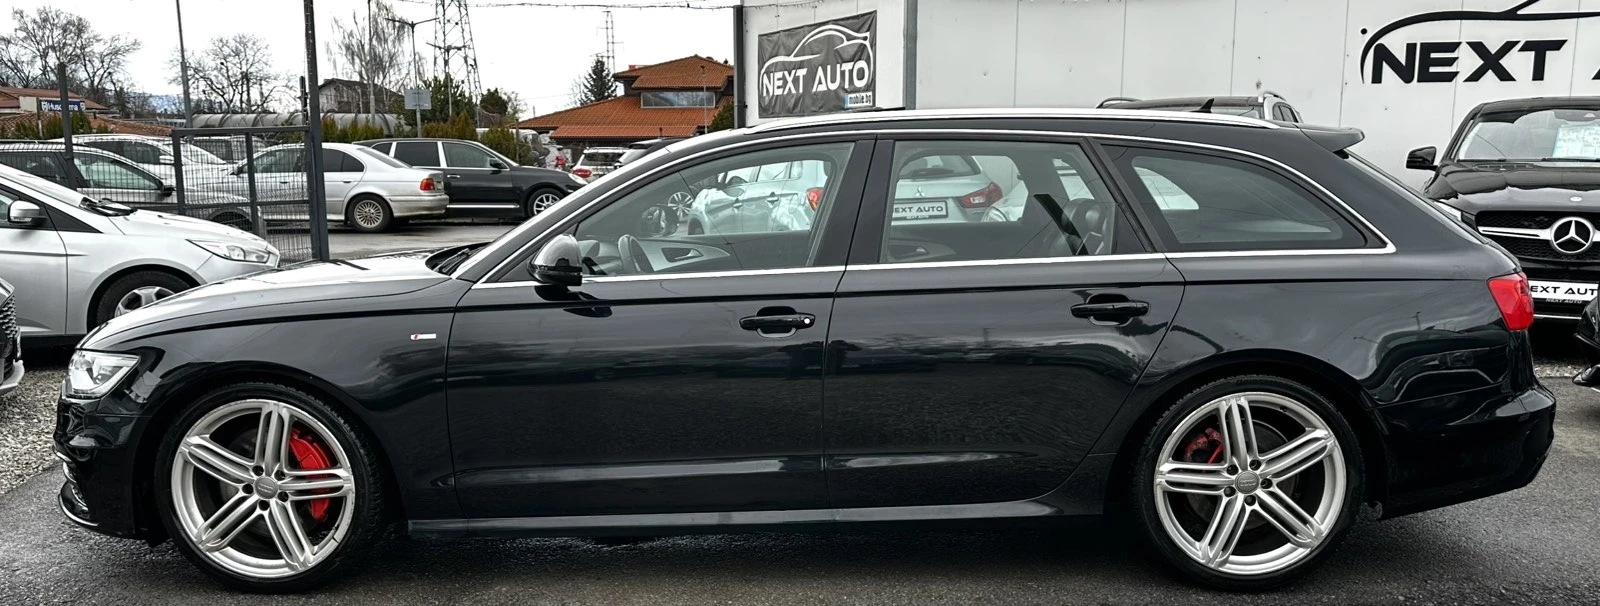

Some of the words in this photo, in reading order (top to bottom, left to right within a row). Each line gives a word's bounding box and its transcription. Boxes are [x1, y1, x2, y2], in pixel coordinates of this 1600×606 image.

[763, 68, 807, 97] NEXT
[812, 60, 869, 92] AUTO
[1371, 39, 1568, 84] NEXT
[1530, 285, 1560, 294] EXT
[1564, 287, 1598, 296] AUT
